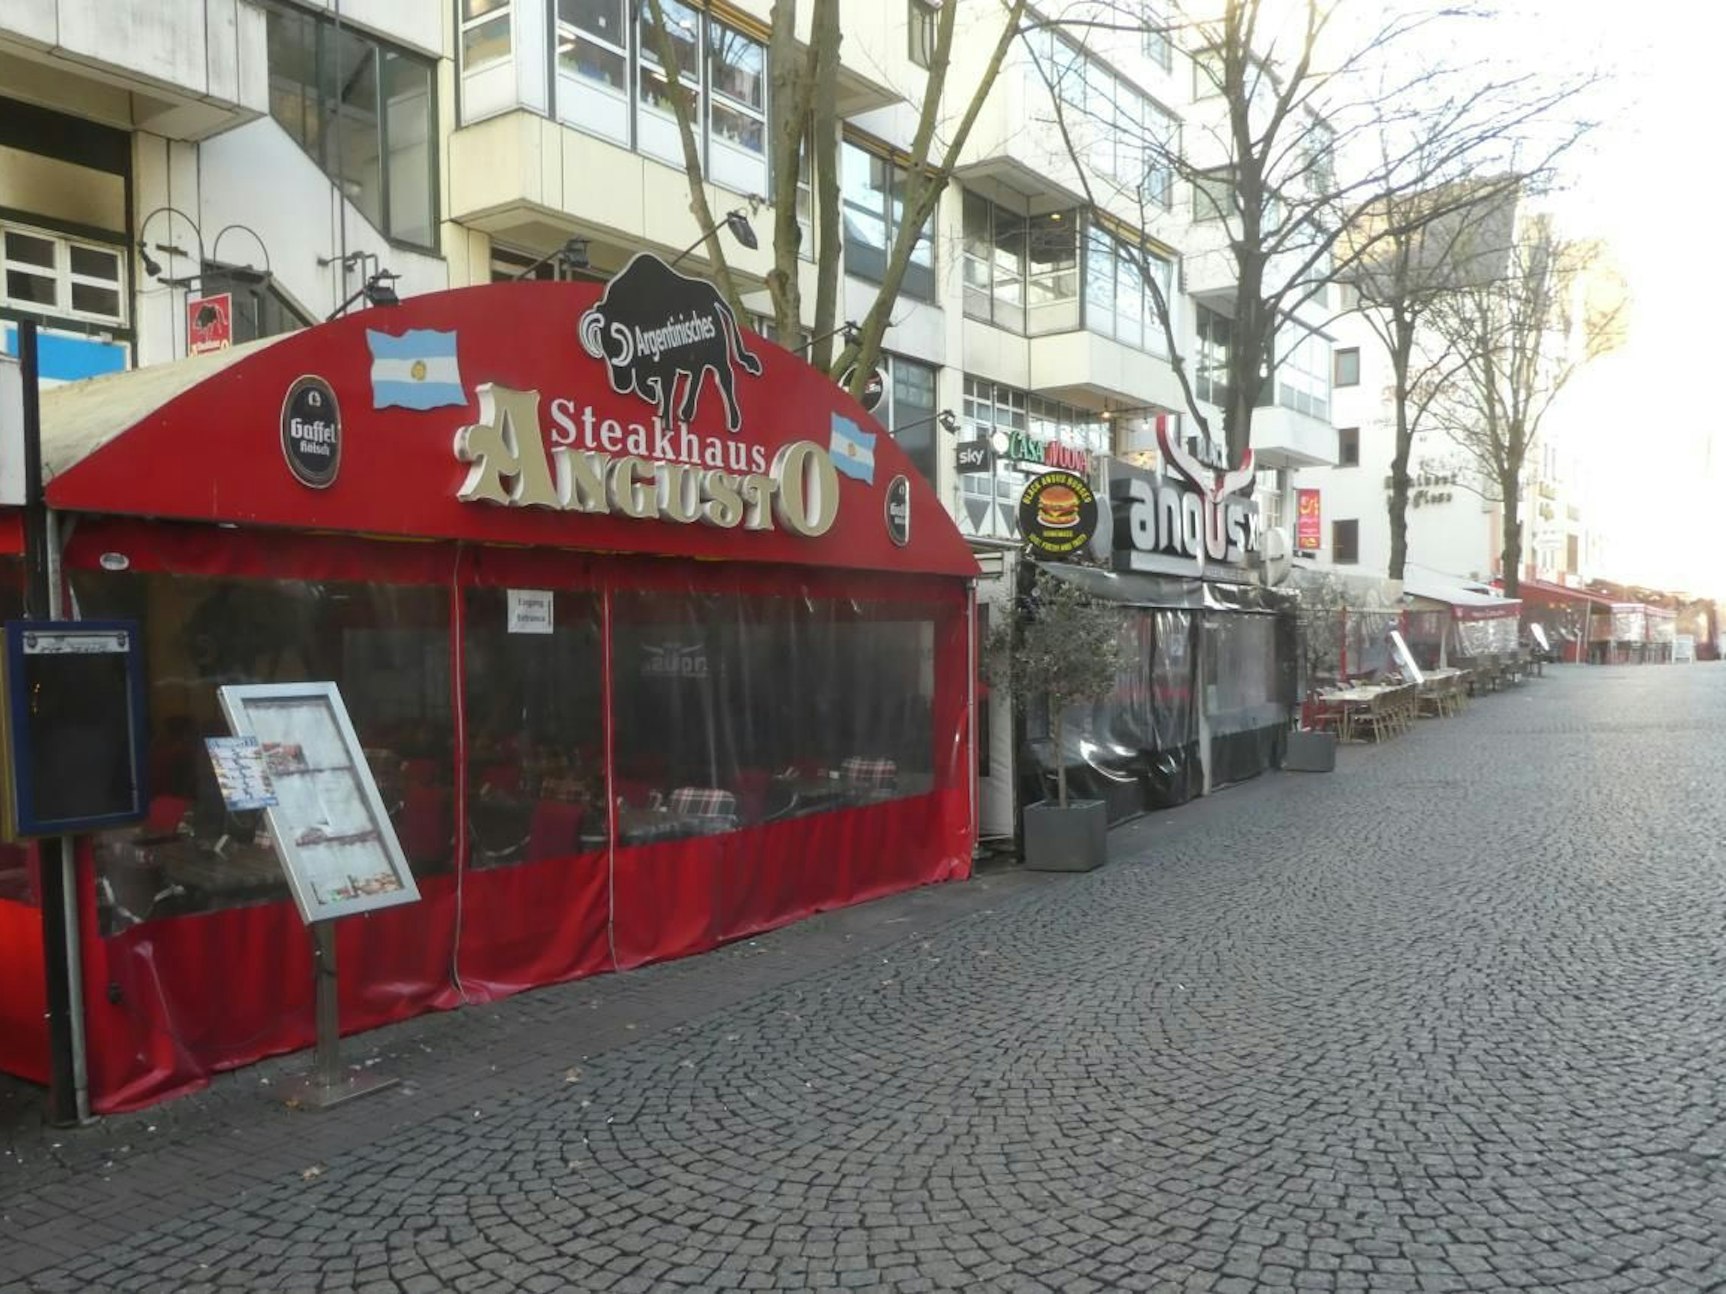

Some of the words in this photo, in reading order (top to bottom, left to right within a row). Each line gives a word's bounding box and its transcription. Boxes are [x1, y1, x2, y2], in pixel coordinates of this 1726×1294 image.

[635, 311, 715, 362] Argentinisches
[290, 417, 336, 444] Gaffel
[550, 398, 767, 474] Steakhaus
[1008, 430, 1044, 463] CASA
[959, 447, 985, 466] sky
[1129, 478, 1246, 578] angus
